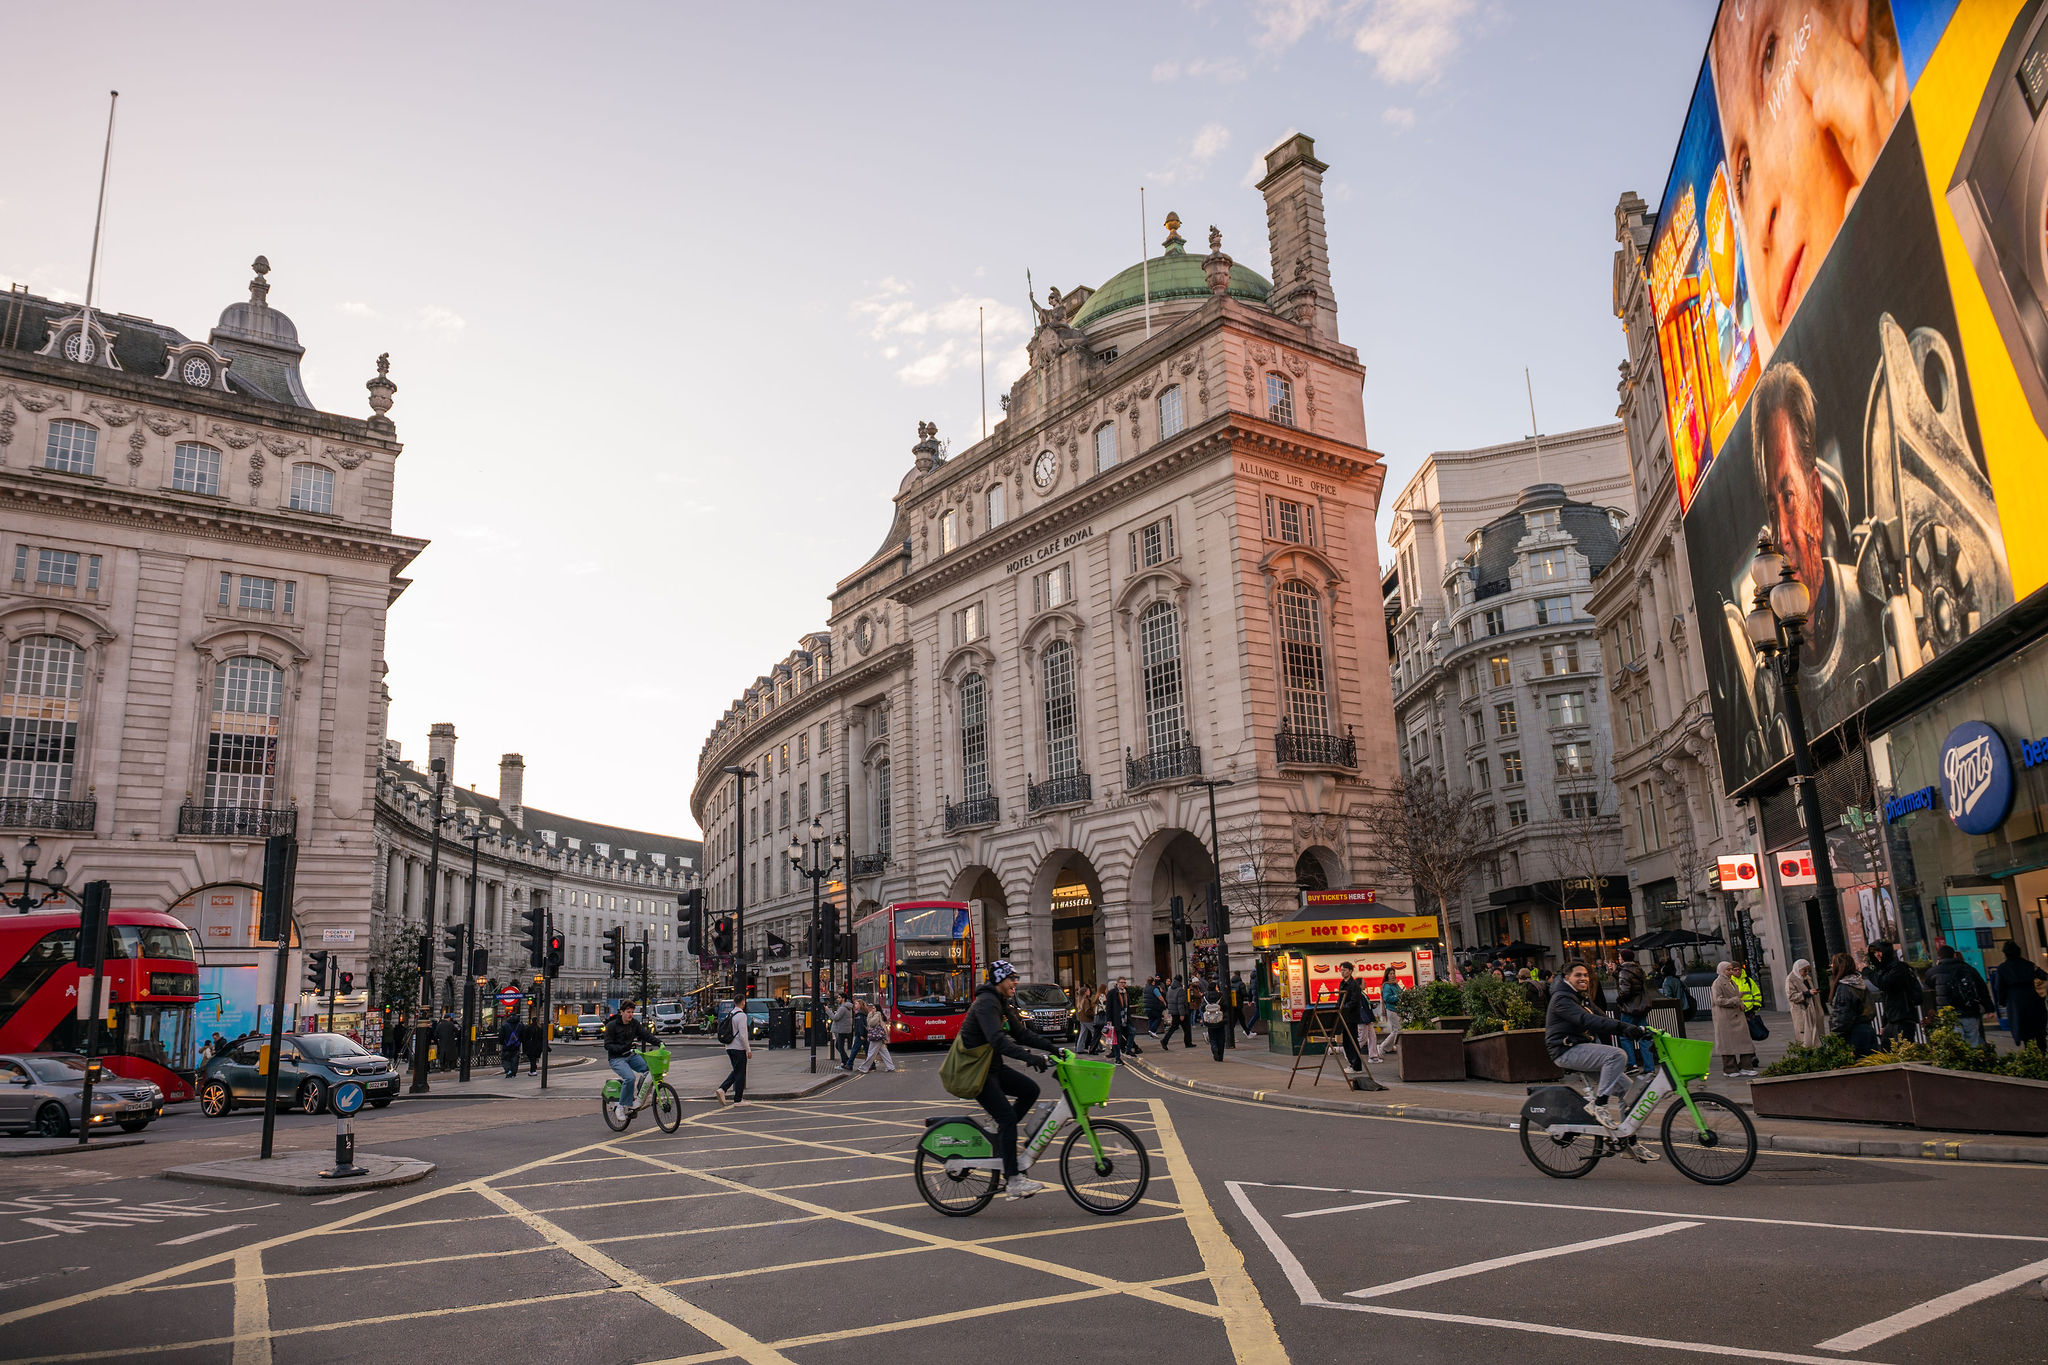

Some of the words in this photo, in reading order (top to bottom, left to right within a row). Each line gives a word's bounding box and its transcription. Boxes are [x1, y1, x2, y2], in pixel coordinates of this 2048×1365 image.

[1767, 13, 1812, 123] Wrinkles
[1239, 462, 1280, 481] ALLIANCE
[1286, 474, 1304, 487] LIFE
[1310, 480, 1337, 496] OFFICE
[1006, 554, 1034, 574] HOTEL
[1037, 538, 1060, 560] CAFÉ
[1063, 525, 1094, 548] ROYAL
[1943, 735, 1993, 819] Boots
[1885, 786, 1934, 824] pharmacy
[1566, 878, 1609, 891] carpo
[1307, 894, 1320, 902] BUY
[1311, 926, 1338, 936] HOT
[1341, 925, 1370, 935] DOG
[1373, 923, 1406, 934] SPOT
[948, 947, 962, 957] 139
[1358, 963, 1386, 972] DOGS
